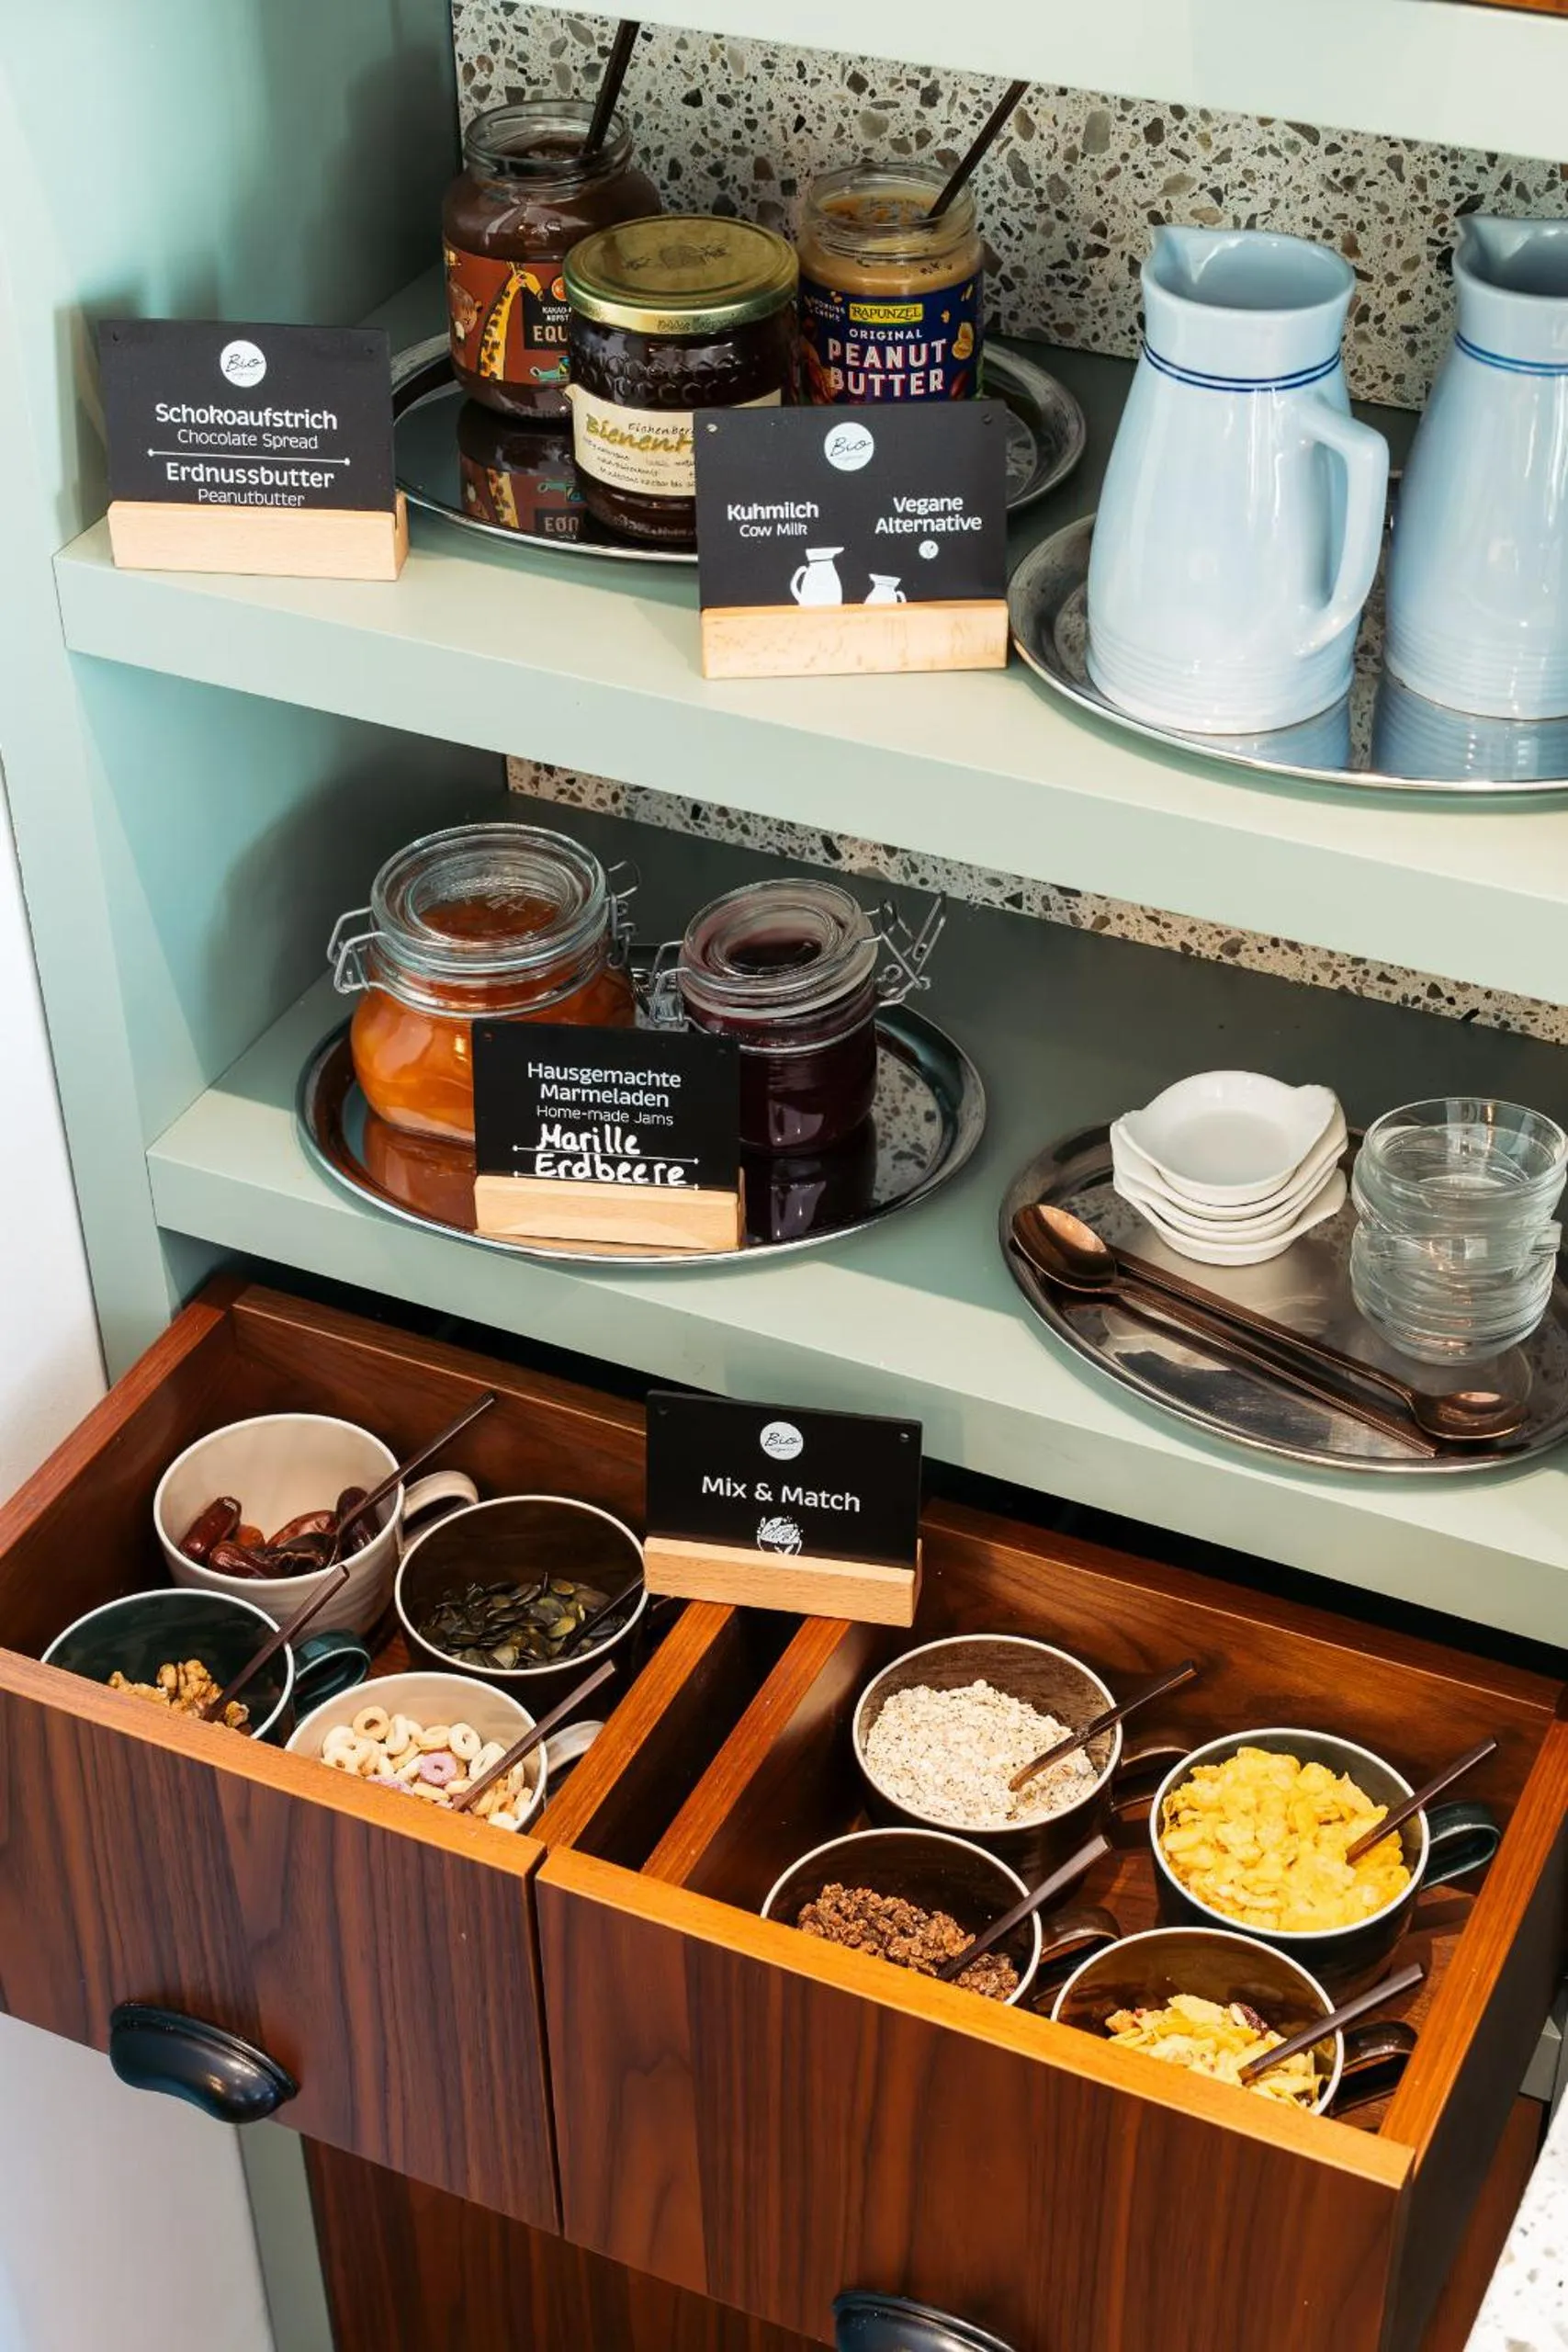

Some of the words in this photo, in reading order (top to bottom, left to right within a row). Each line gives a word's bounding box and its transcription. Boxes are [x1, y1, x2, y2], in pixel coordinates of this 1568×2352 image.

[851, 304, 921, 321] RAPUNZEL
[849, 328, 922, 341] ORIGINAL
[225, 353, 265, 373] Bio
[828, 337, 947, 368] PEANUT
[829, 367, 944, 397] BUTTER
[155, 402, 338, 430] Schokoaufstrich
[176, 428, 258, 447] Chocolate
[262, 433, 319, 450] Spread
[829, 436, 873, 457] Bio
[165, 461, 335, 489] Erdnussbutter
[197, 488, 305, 507] Peanutbutter
[893, 496, 964, 516] Vegane
[727, 501, 819, 521] Kuhmilch
[739, 524, 773, 537] Cow
[776, 522, 808, 537] Milk
[874, 514, 983, 535] Alternative
[527, 1061, 682, 1089] Hausgemachte
[540, 1083, 670, 1108] Marmeladen
[536, 1104, 630, 1124] Home-made
[634, 1111, 674, 1126] Jams
[536, 1123, 641, 1155] Marille
[535, 1152, 688, 1185] Erdbeere
[764, 1431, 801, 1447] Bio
[702, 1476, 747, 1498] Mix
[754, 1482, 773, 1502] &
[781, 1485, 861, 1512] Match
